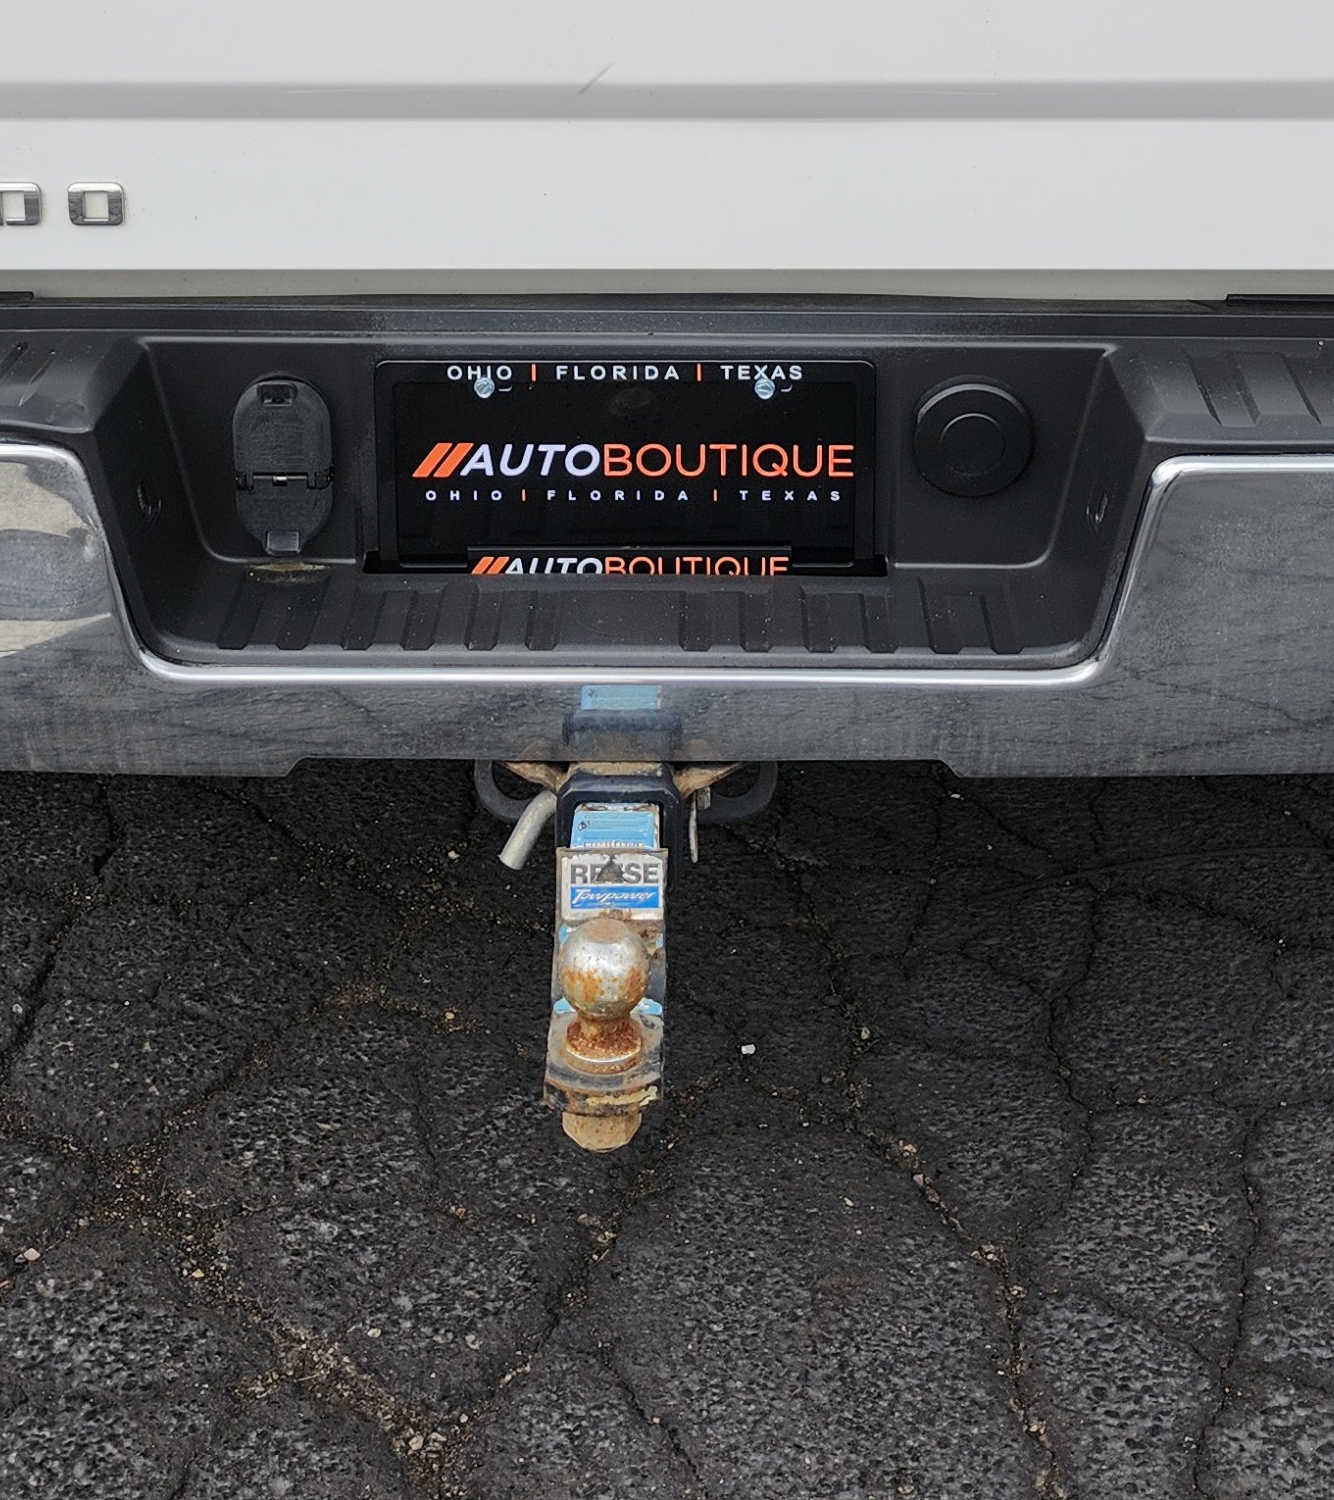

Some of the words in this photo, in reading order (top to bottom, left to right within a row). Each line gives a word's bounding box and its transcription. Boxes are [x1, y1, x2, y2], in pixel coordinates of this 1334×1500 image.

[447, 365, 512, 381] OHIO
[556, 365, 680, 381] FLORIDA
[720, 365, 803, 381] TEXAS
[460, 443, 855, 478] AUTOBOUTIQUE
[425, 489, 503, 502] OHIO
[547, 489, 689, 502] FLORIDA
[739, 489, 841, 502] TEXAS
[571, 863, 660, 884] RESE
[572, 888, 657, 905] Towpower
